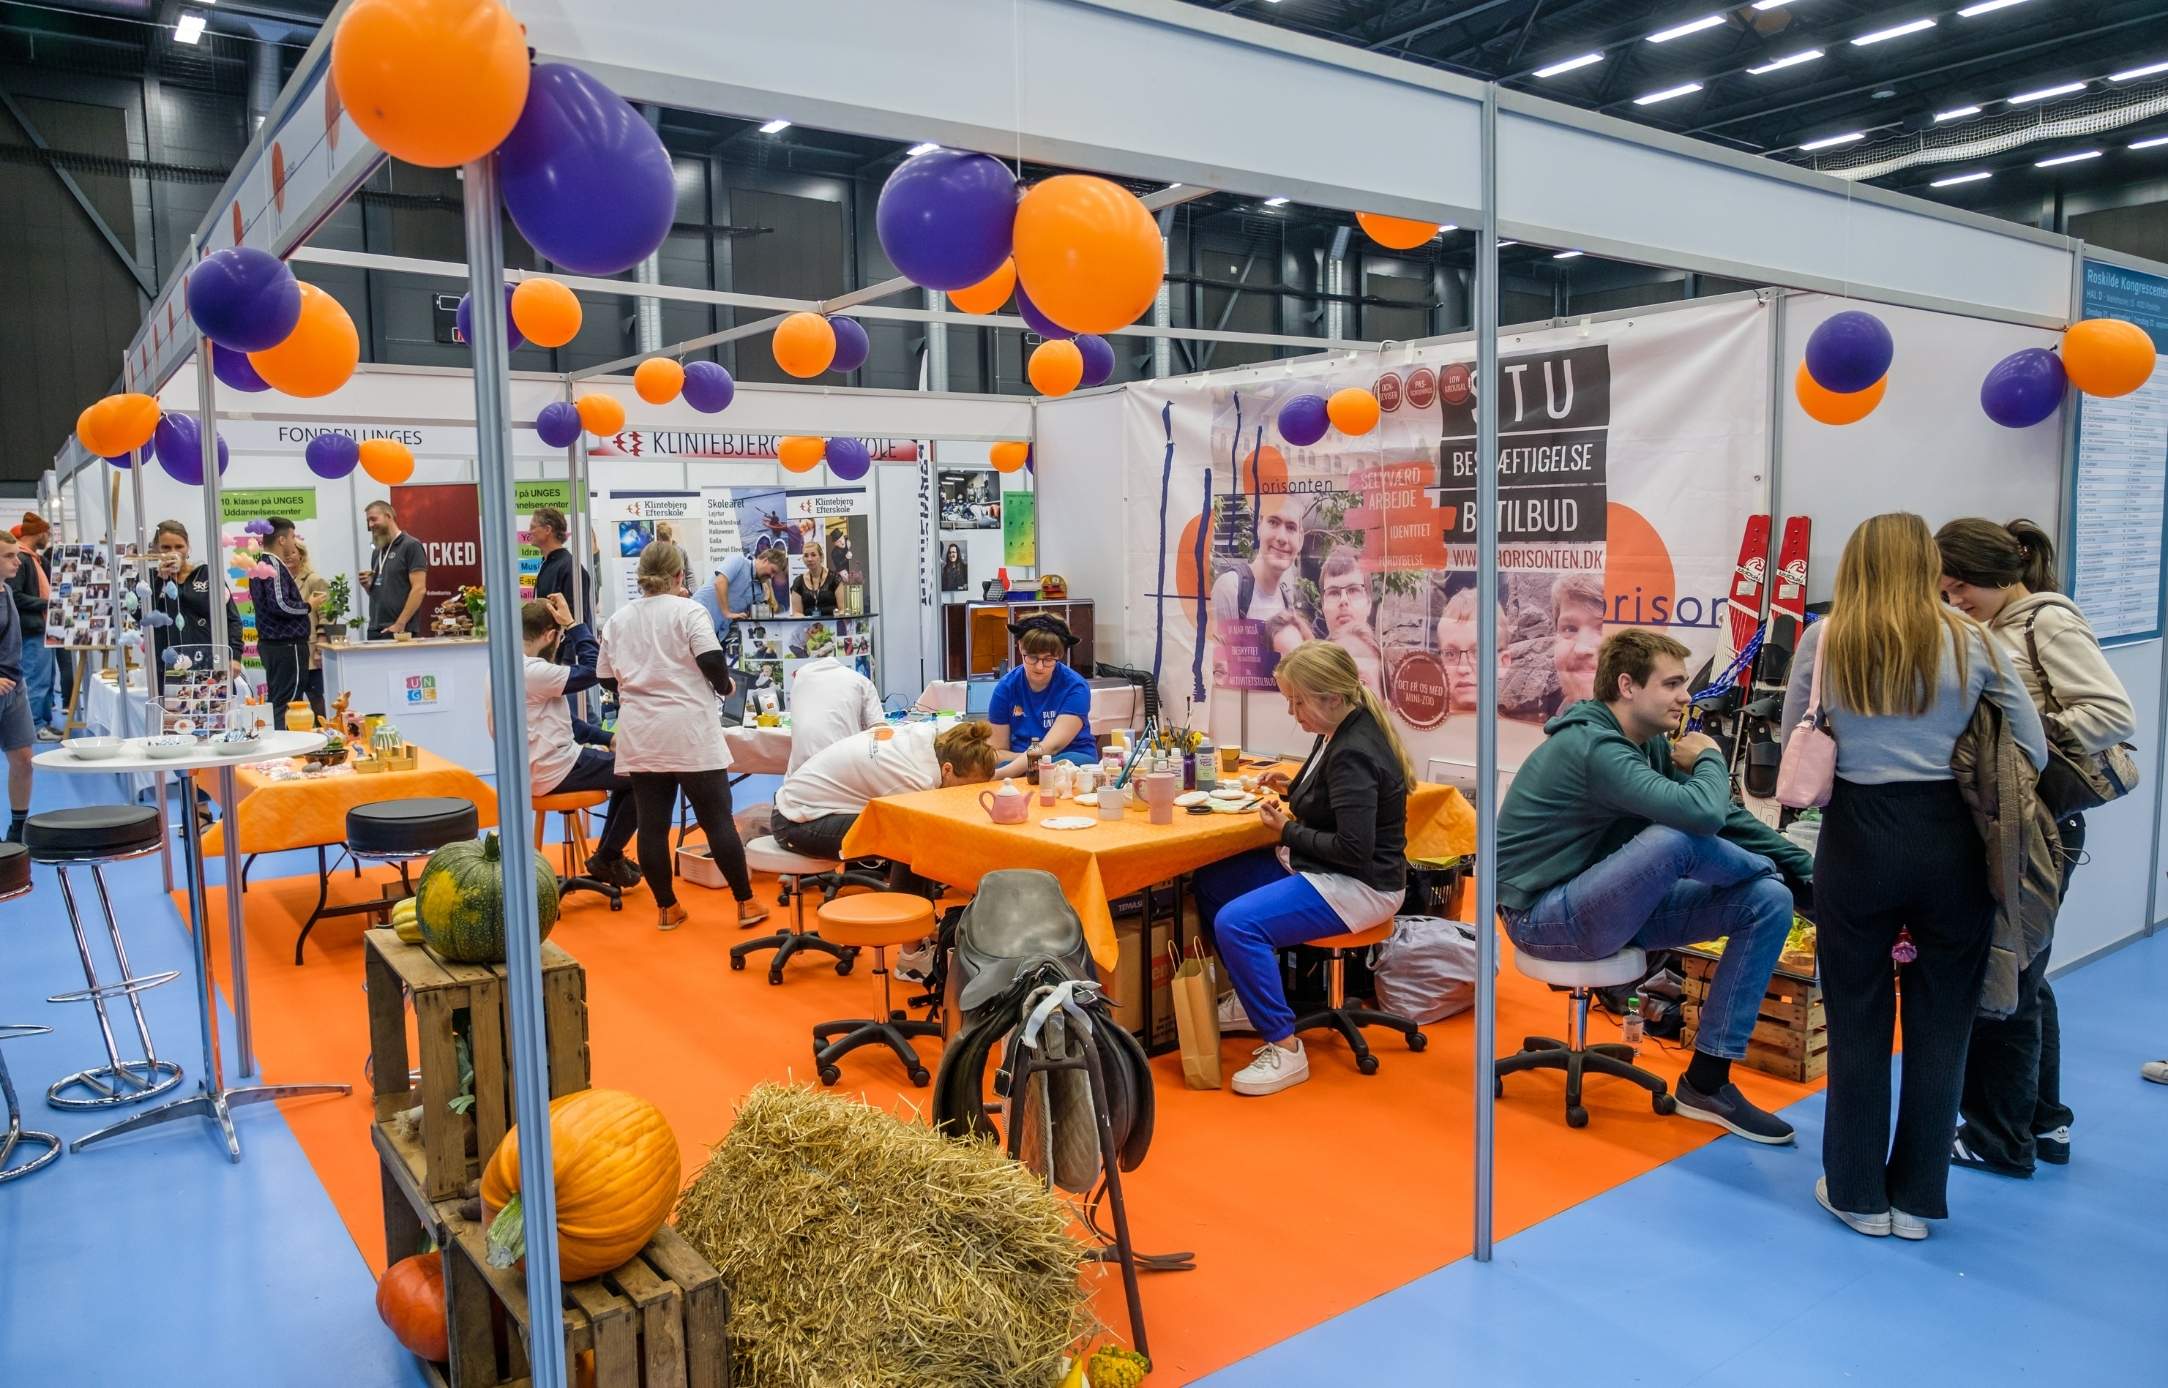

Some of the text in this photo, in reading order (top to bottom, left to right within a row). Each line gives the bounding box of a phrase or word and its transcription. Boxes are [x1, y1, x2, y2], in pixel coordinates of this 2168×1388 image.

[2087, 269, 2119, 288] Roskilde
[2086, 289, 2097, 300] HAL
[1449, 376, 1460, 384] LOW
[1453, 444, 1593, 477] BEÆFTIGELSE
[531, 489, 560, 498] UNGES
[233, 497, 258, 506] klasse
[262, 496, 271, 506] på
[273, 496, 303, 505] UNGES
[815, 498, 854, 507] Klintebjerg
[1369, 489, 1416, 511] ARBEJDE
[645, 501, 687, 510] Klintebjerg
[816, 506, 851, 514] Efterskole
[224, 508, 301, 516] Uddannelsescenter
[646, 508, 684, 517] Efterskole
[1462, 498, 1578, 533] BTILBUD
[1391, 523, 1430, 539] IDENTITET
[1398, 680, 1443, 697] DET ER OS MED
[1405, 692, 1435, 706] MINI-ZOO
